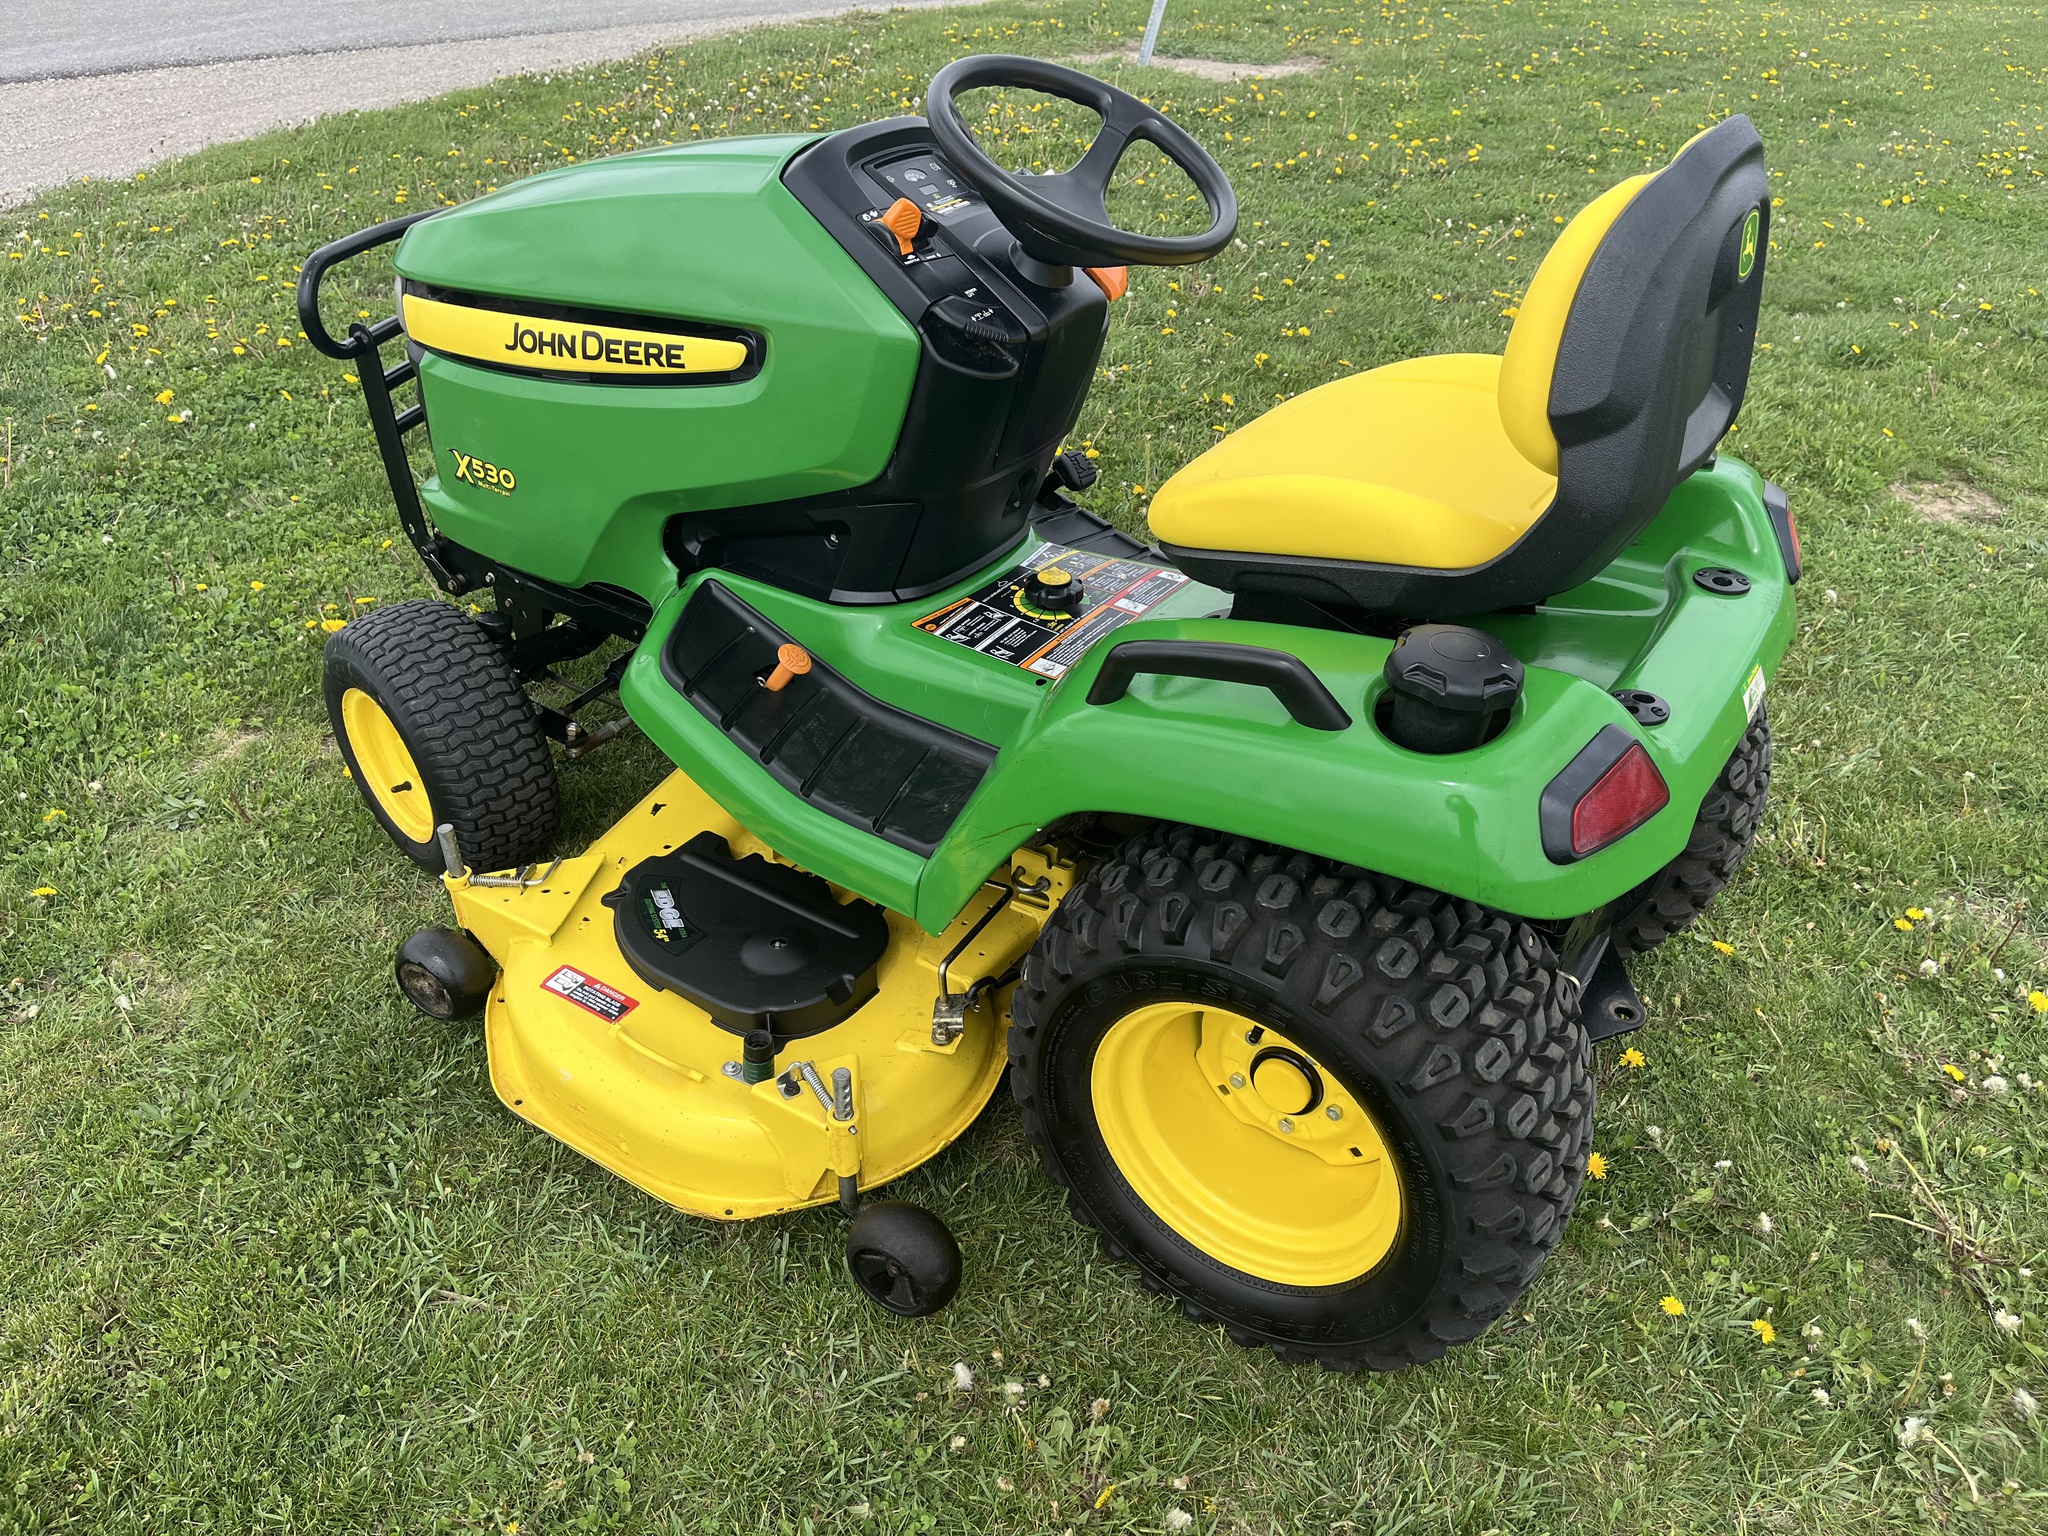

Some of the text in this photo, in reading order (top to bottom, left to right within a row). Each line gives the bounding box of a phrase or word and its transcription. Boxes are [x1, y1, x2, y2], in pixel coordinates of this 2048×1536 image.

[504, 322, 686, 369] JOHN DEERE
[448, 449, 516, 491] X530
[650, 889, 684, 929] EDGE
[601, 985, 626, 1002] DANGER
[1084, 970, 1294, 1028] CARLISLE
